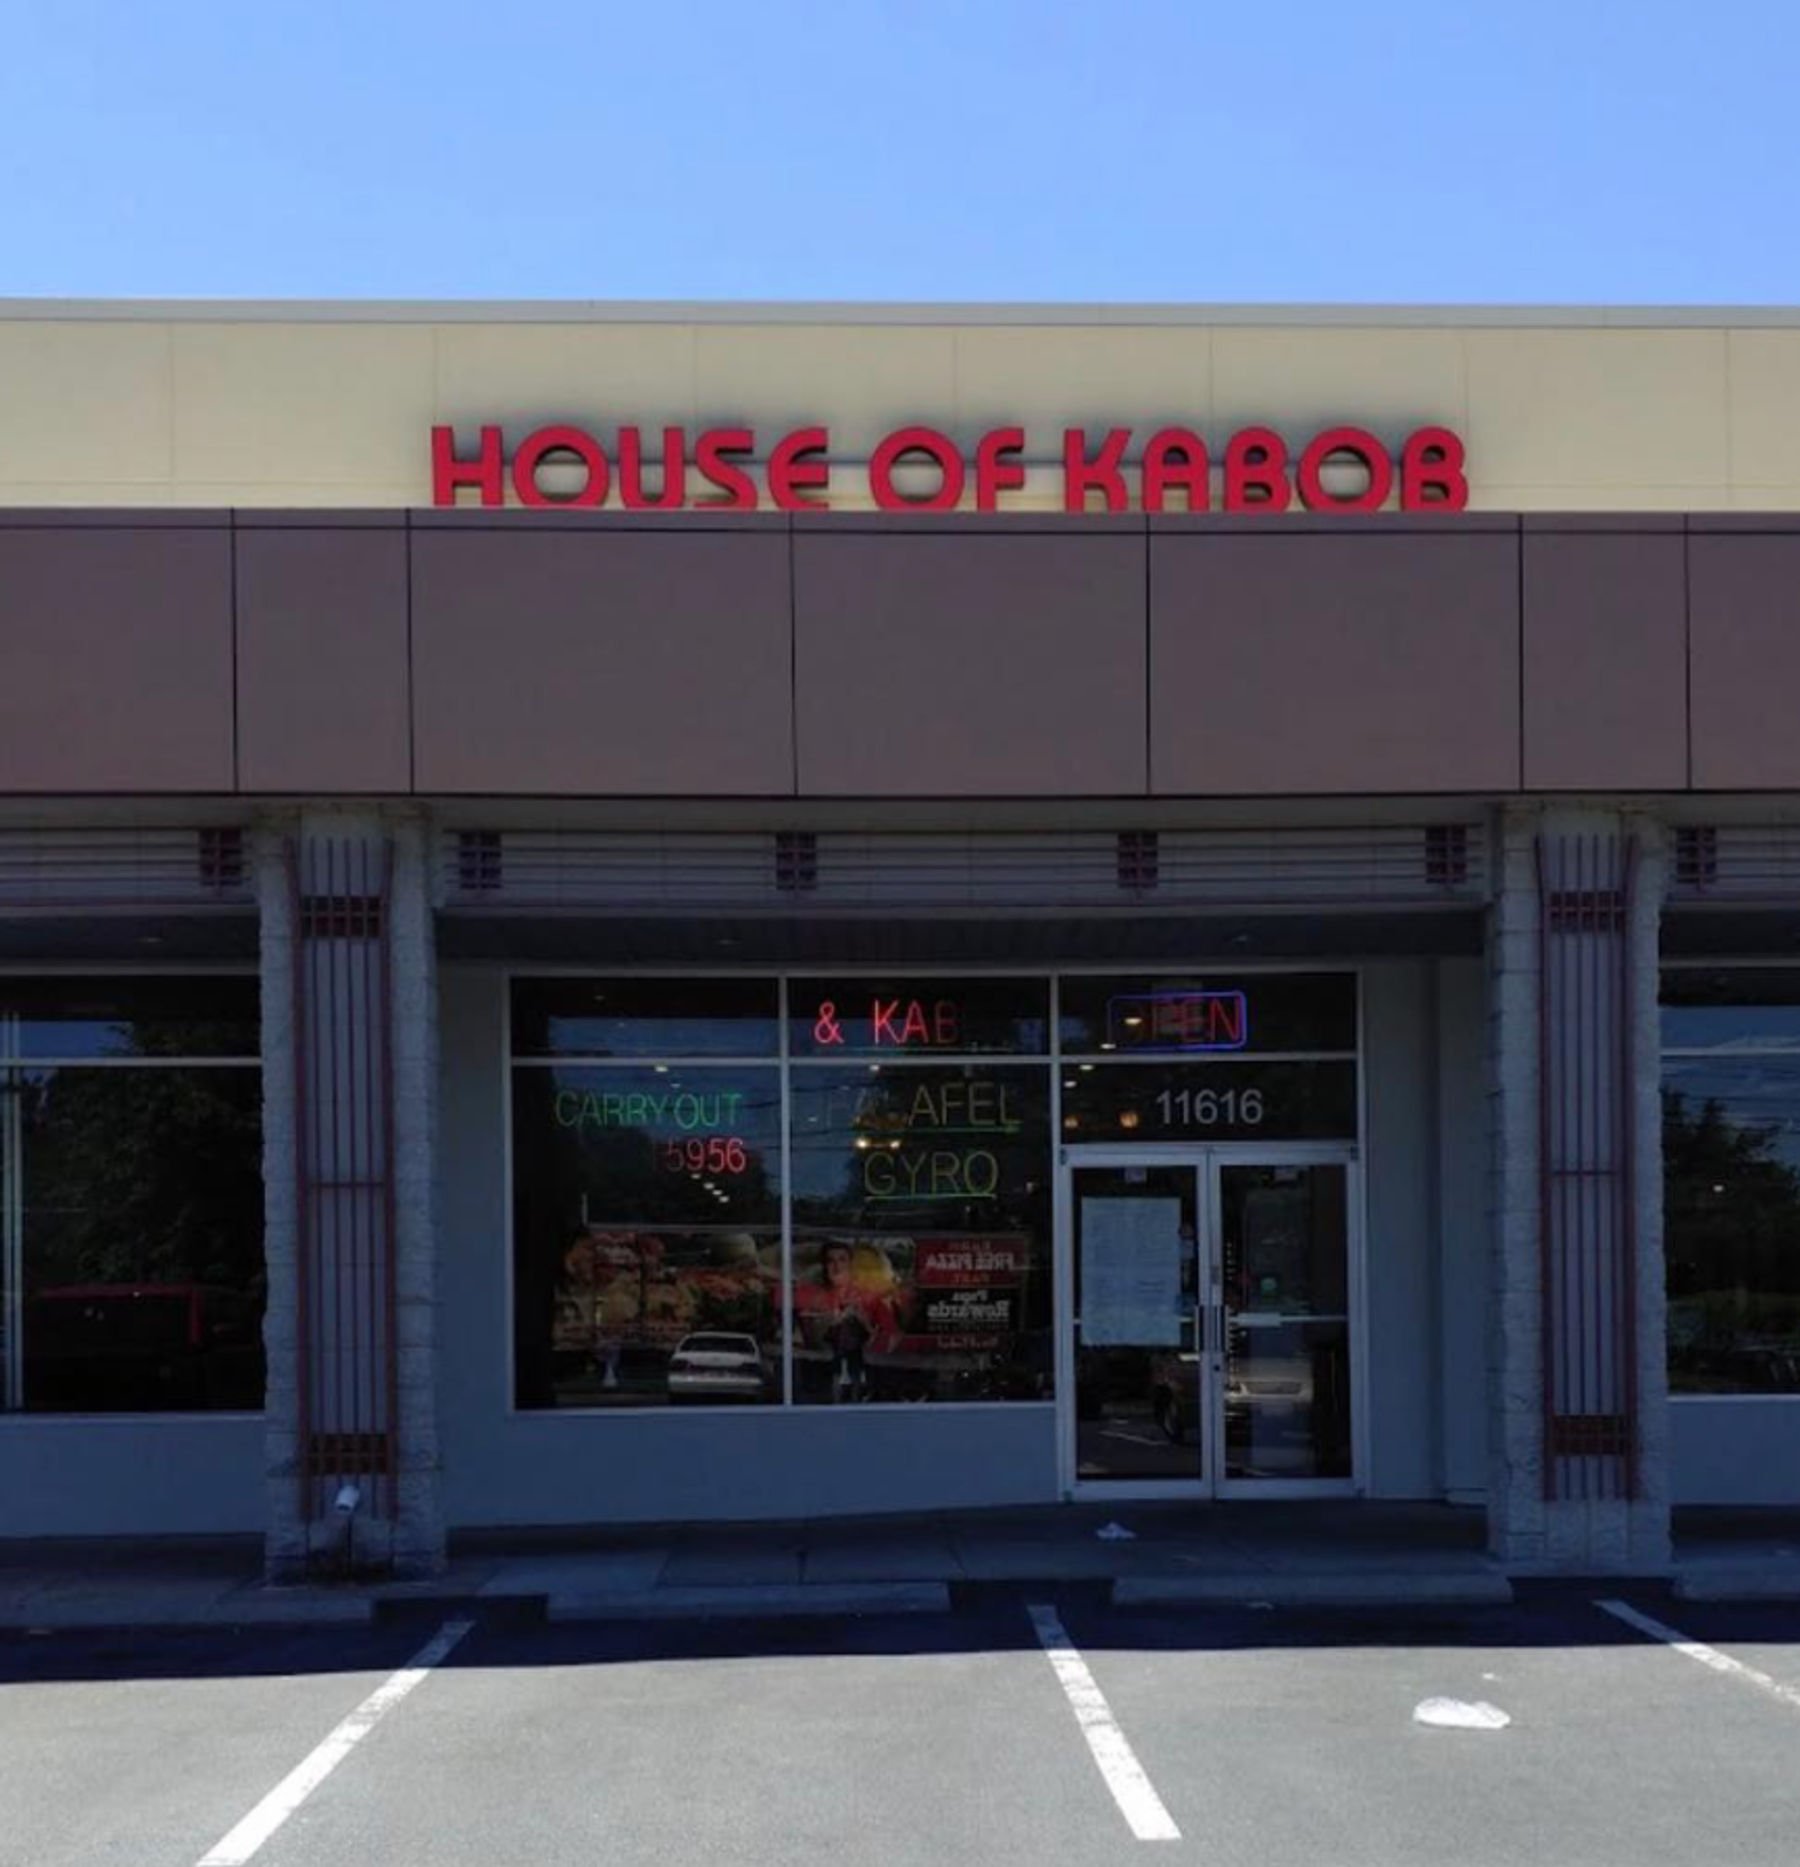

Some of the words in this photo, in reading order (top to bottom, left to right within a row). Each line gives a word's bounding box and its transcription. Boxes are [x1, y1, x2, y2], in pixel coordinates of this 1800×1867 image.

[431, 425, 829, 511] HOUSE
[869, 426, 1025, 513] OF
[1064, 426, 1470, 513] KABOB
[813, 1000, 846, 1045] &
[1118, 997, 1243, 1044] PEN
[554, 1089, 668, 1127] CARRY
[673, 1091, 743, 1130] OUT
[1155, 1088, 1264, 1125] 11616
[863, 1150, 999, 1197] GYRO
